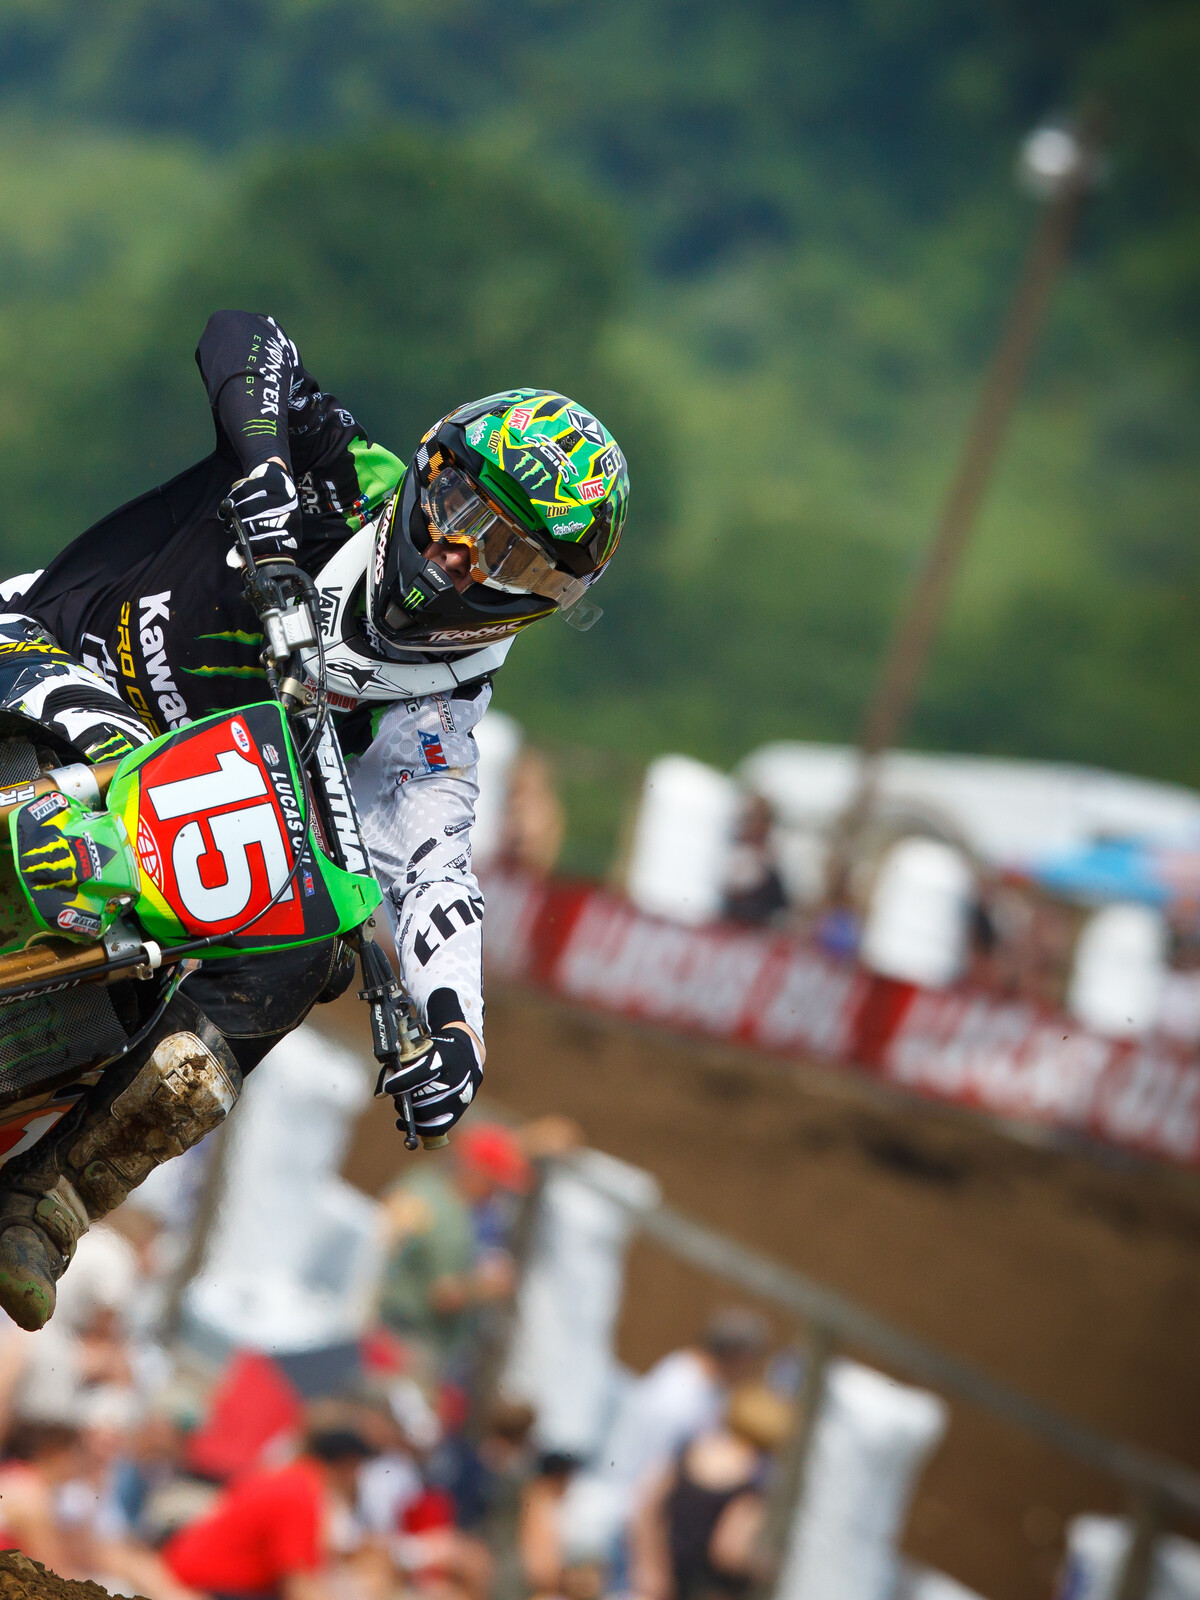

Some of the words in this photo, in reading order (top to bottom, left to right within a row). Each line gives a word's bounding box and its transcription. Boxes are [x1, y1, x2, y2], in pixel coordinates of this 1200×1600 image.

[508, 408, 533, 431] VANS
[577, 478, 606, 501] VANS
[546, 504, 572, 519] thor
[427, 567, 447, 585] thor
[319, 586, 343, 637] VANS
[417, 729, 450, 772] AMA
[271, 771, 303, 832] LUCAS
[146, 748, 296, 923] 15
[75, 838, 92, 879] VANS
[302, 868, 316, 897] AMA
